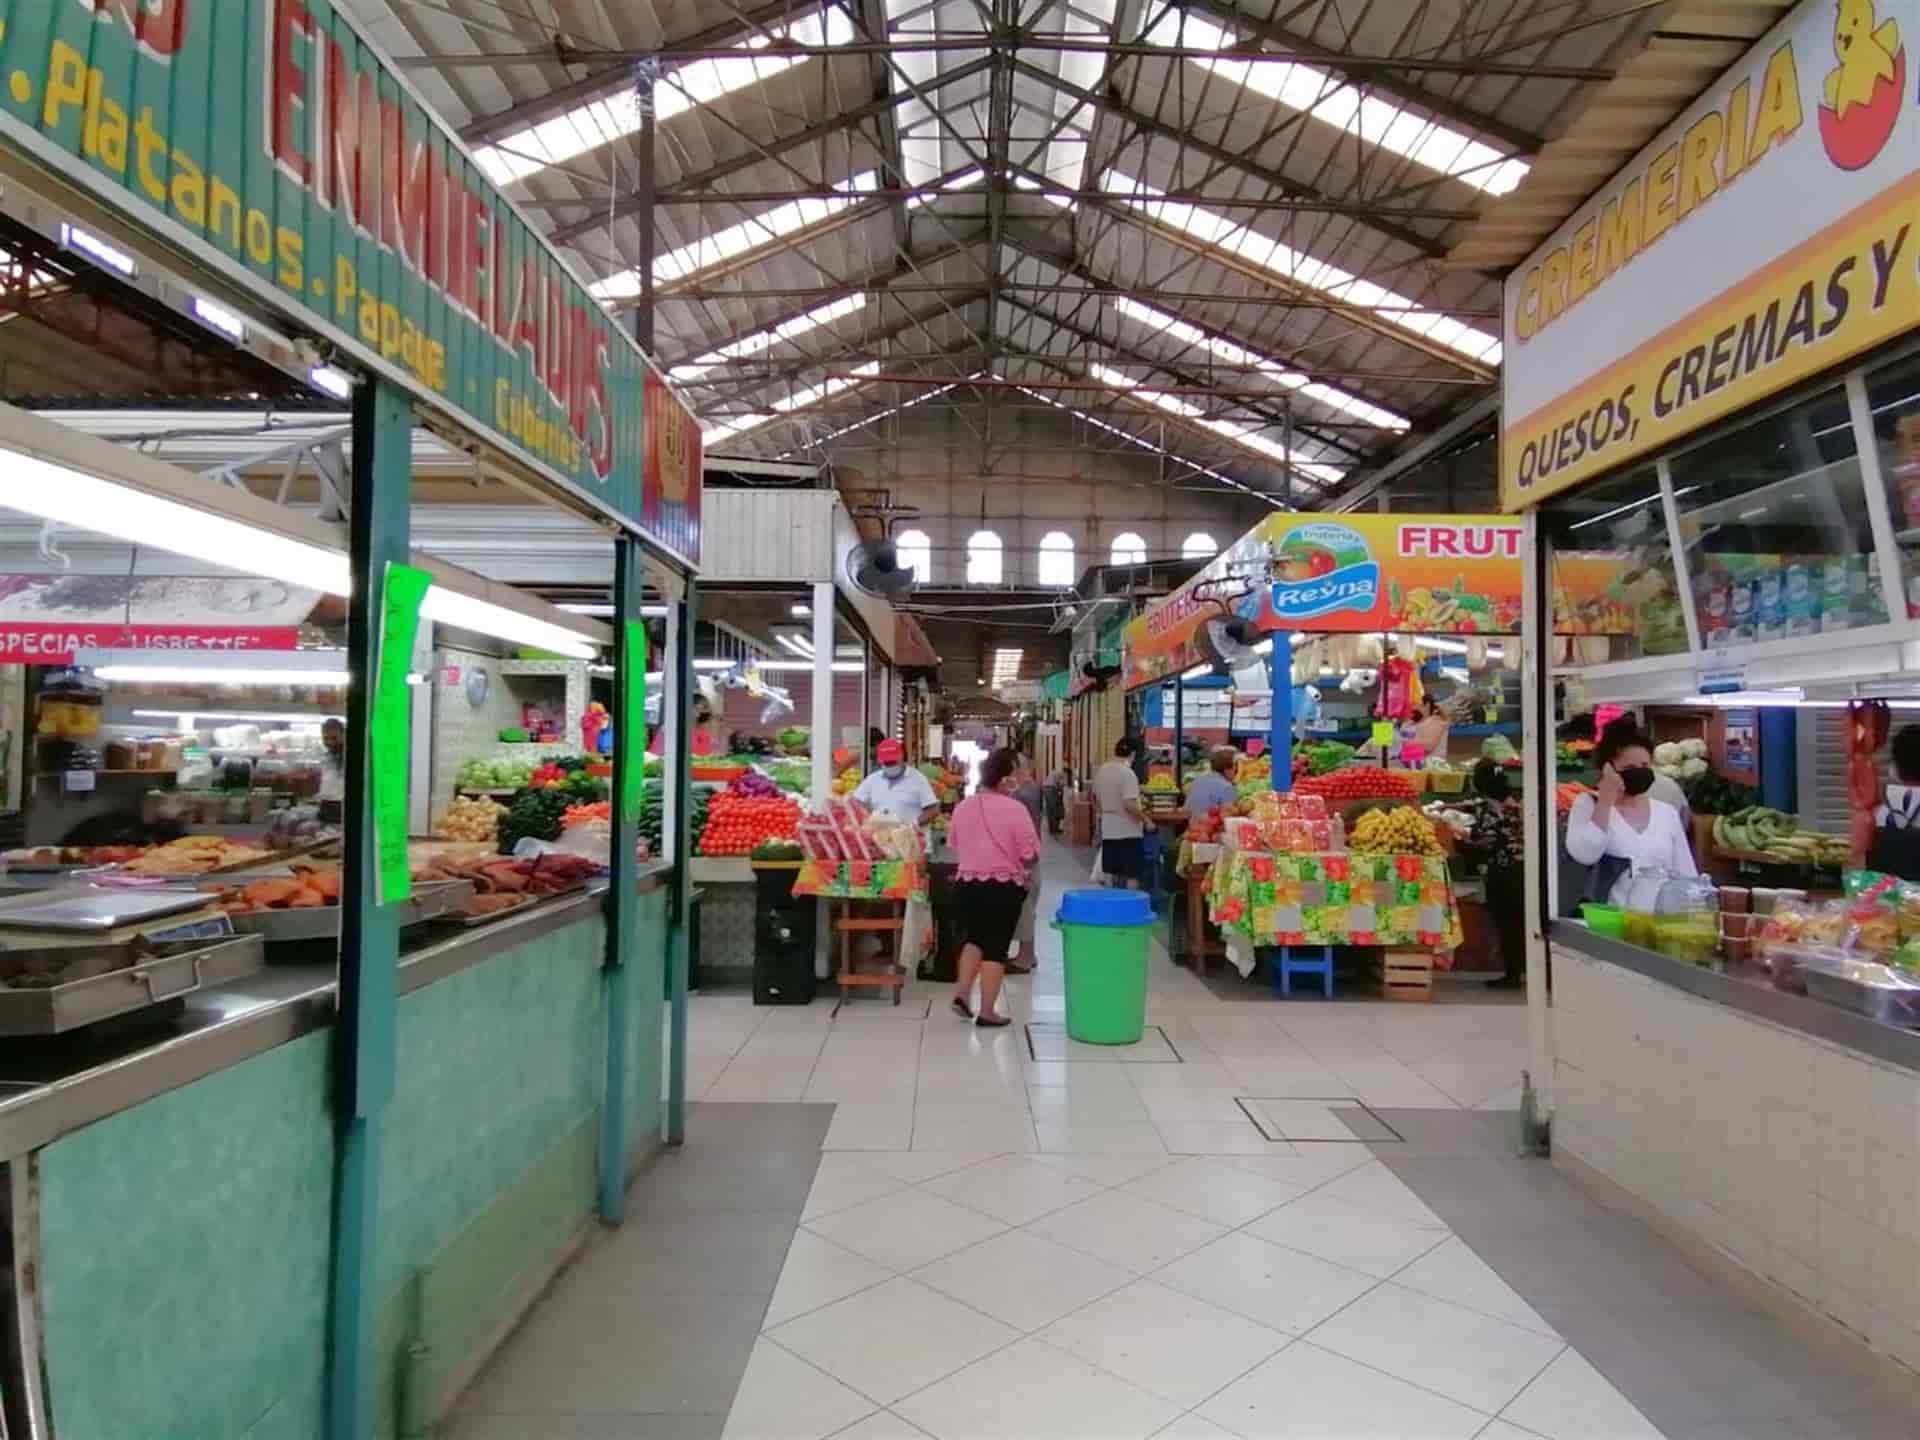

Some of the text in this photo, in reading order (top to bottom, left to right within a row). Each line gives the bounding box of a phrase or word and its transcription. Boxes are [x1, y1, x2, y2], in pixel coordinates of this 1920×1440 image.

[1515, 40, 1804, 343] CREMERIA
[1517, 223, 1911, 487] QUESOS, CREMAS Y
[1279, 576, 1371, 607] Reyna
